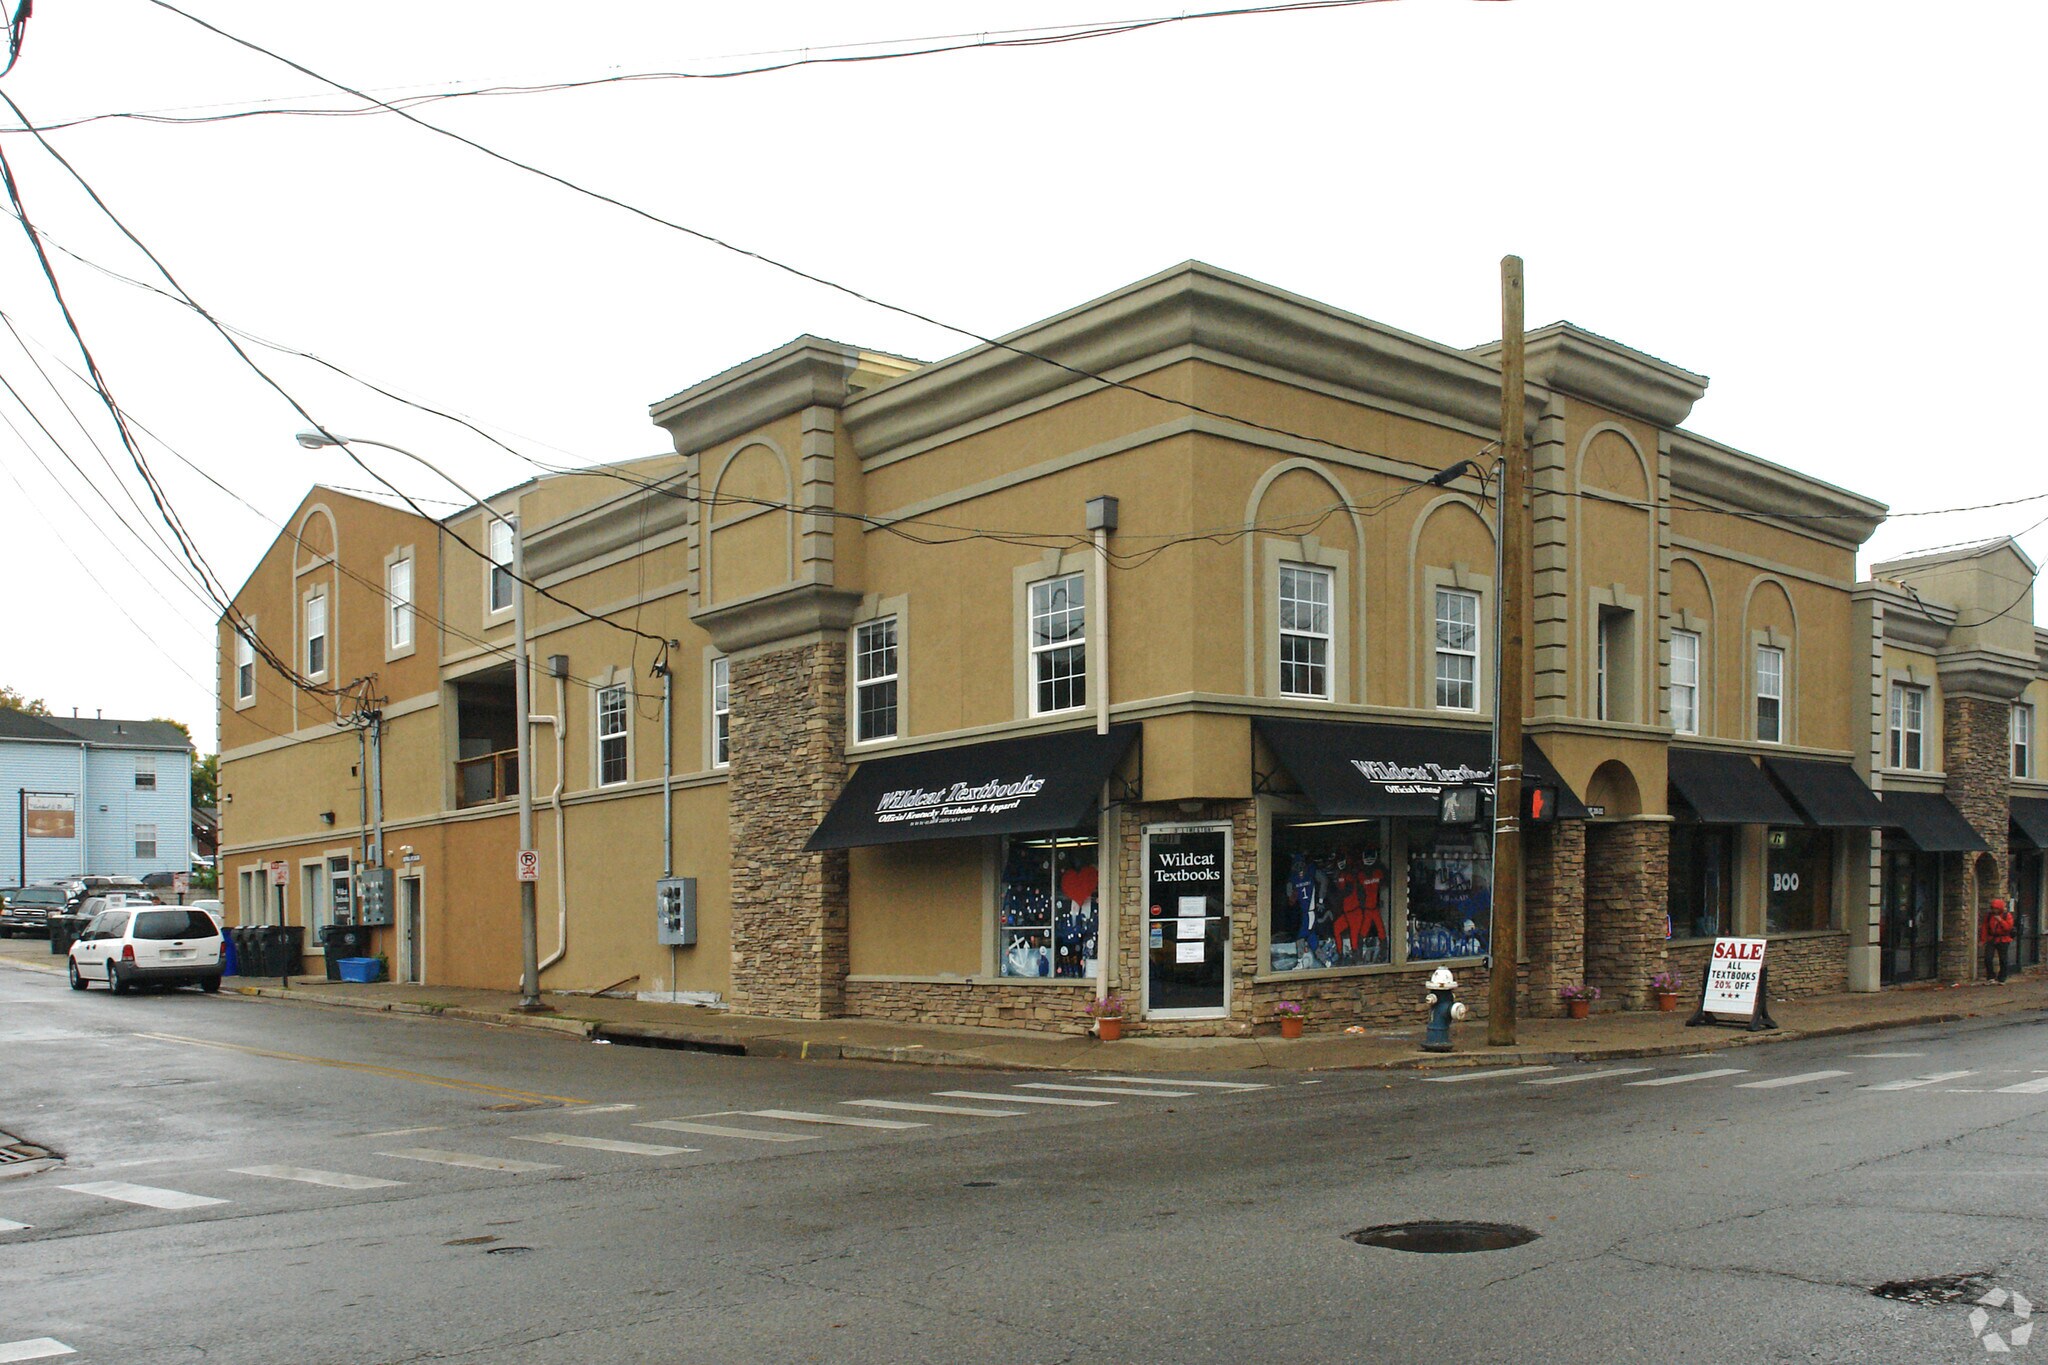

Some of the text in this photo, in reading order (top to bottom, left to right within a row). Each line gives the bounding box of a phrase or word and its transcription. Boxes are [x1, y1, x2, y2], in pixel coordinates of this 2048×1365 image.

[1351, 760, 1432, 781] Wildcat
[877, 774, 1045, 811] Wildcat Textbooks
[878, 811, 907, 822] Official
[905, 809, 940, 819] Kentucky
[940, 805, 980, 815] Textbooks
[980, 804, 988, 812] &
[987, 799, 1020, 813] Apparel
[1159, 852, 1215, 867] Wildcat
[1154, 868, 1220, 882] Textbooks
[1773, 872, 1799, 891] BOO
[1301, 886, 1309, 900] 1
[1714, 942, 1763, 960] SALE
[1727, 961, 1741, 970] ALL
[1712, 970, 1756, 981] TEXTBOOKS
[1735, 981, 1750, 990] OFF
